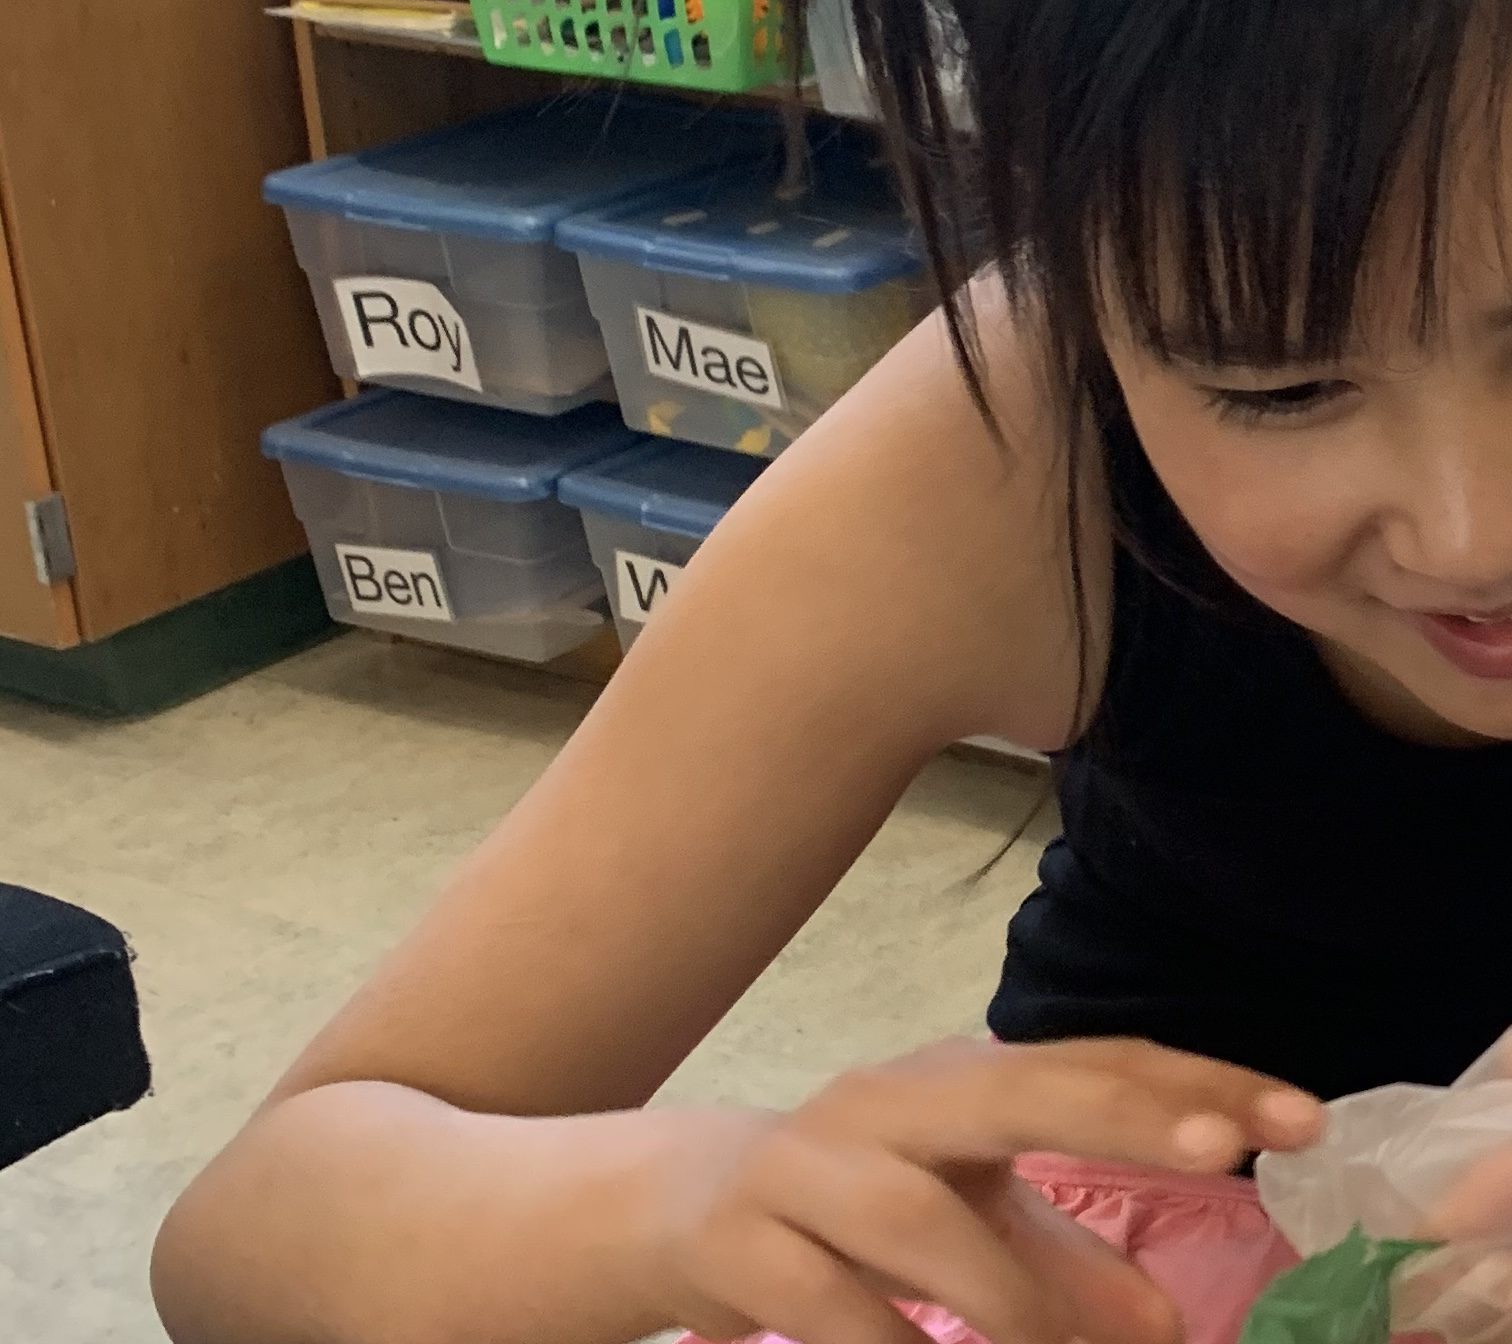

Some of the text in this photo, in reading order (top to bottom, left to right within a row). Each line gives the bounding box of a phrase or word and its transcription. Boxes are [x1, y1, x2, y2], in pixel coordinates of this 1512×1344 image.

[352, 291, 462, 372] Roy
[646, 315, 769, 395] Mae
[344, 554, 442, 607] Ben
